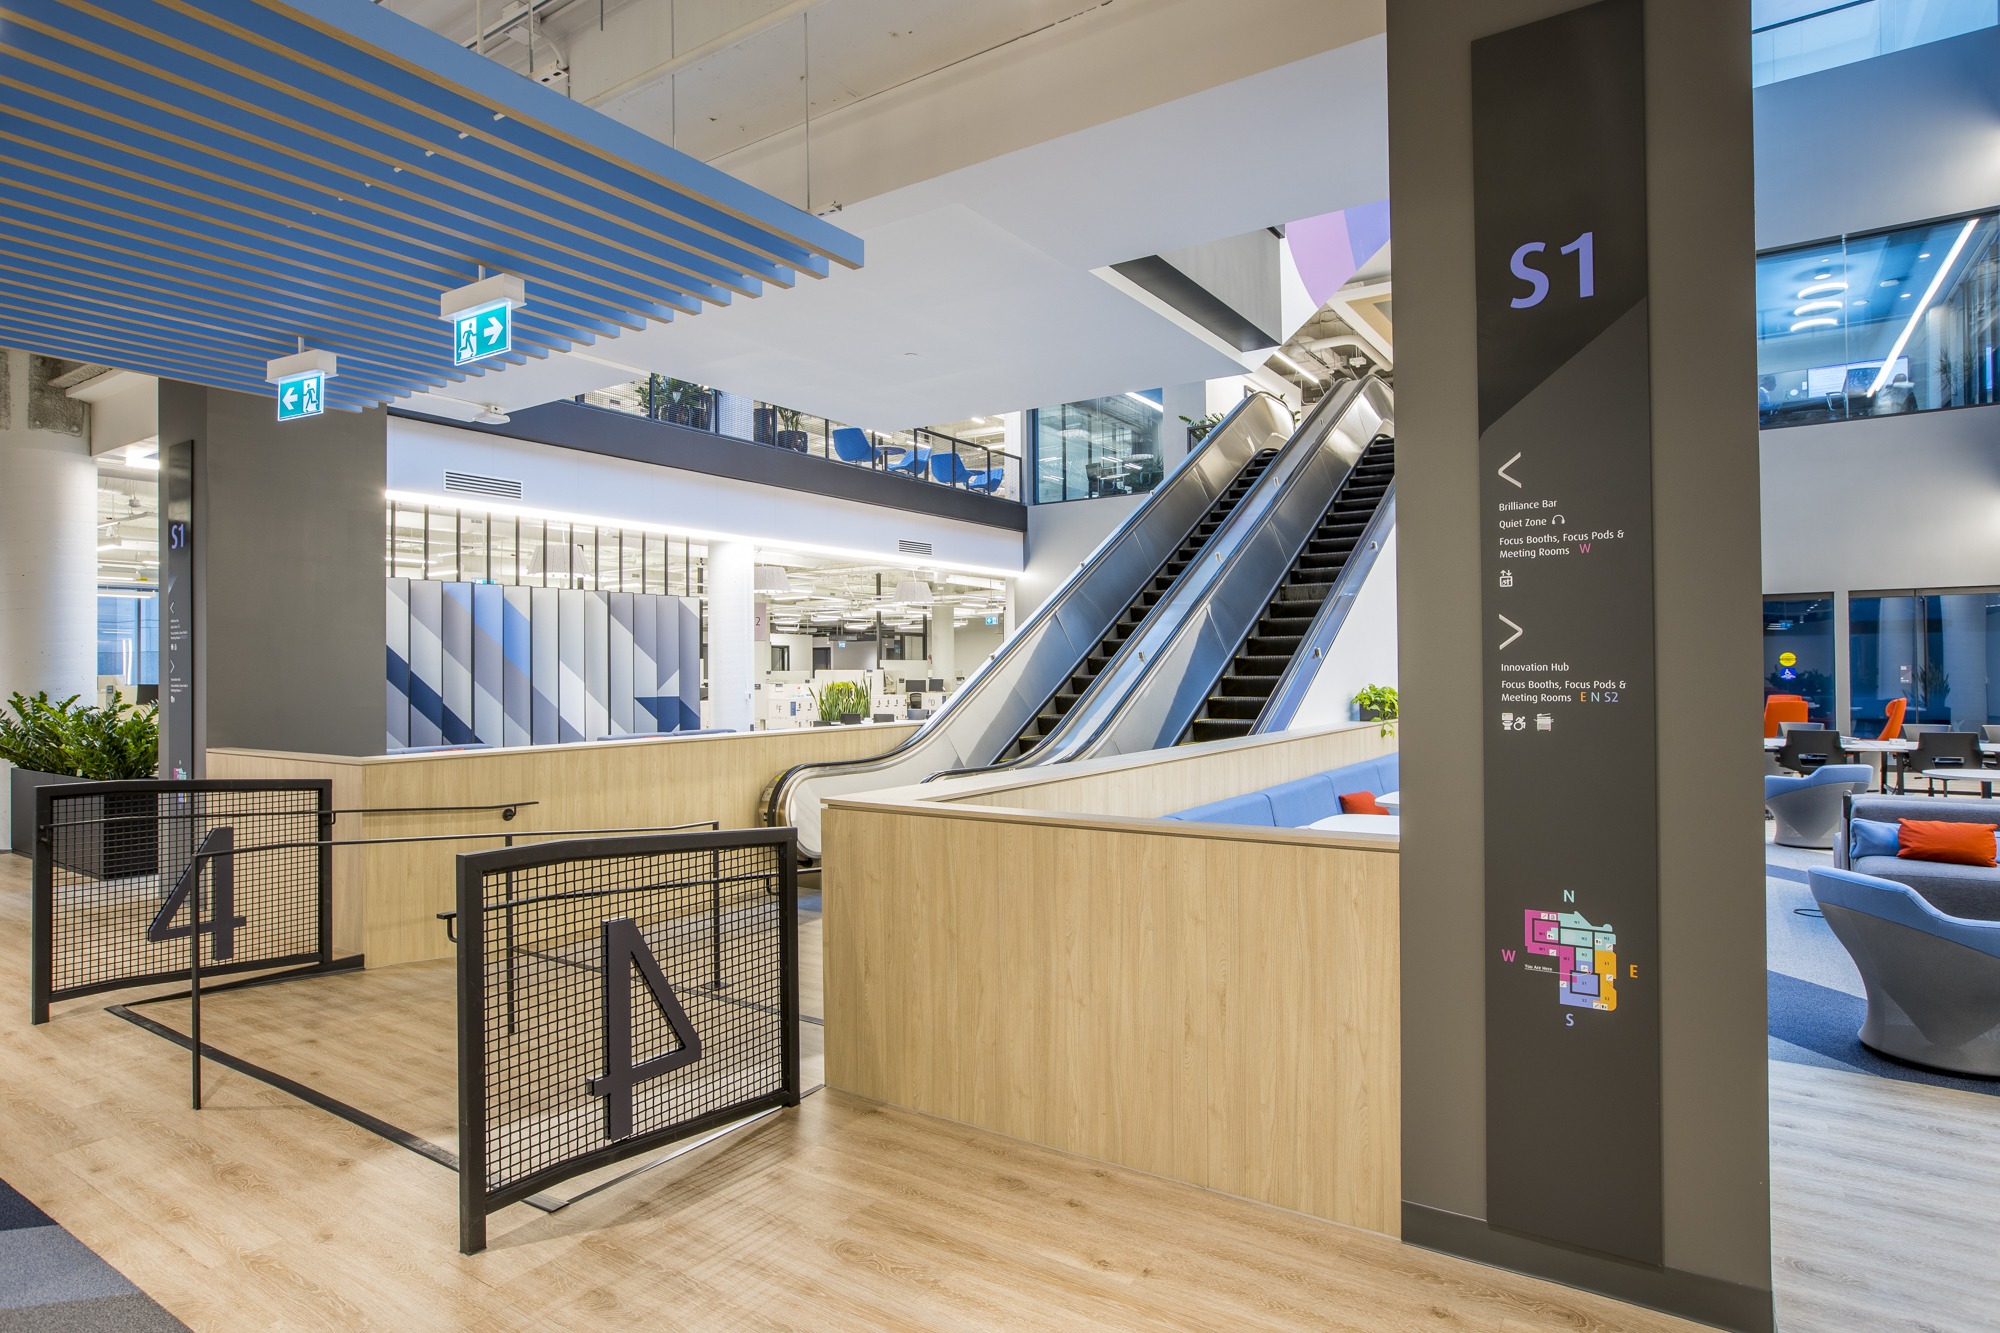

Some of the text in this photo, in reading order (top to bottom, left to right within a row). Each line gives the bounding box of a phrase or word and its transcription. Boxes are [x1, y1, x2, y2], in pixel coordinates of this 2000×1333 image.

[1510, 231, 1594, 309] S1
[1498, 499, 1558, 512] Brilliance Bar
[1499, 518, 1547, 530] Quiet Zone
[171, 523, 185, 549] S1
[1499, 529, 1625, 546] Focus Booths, Focus Pods &
[1499, 543, 1592, 559] Meeting Rooms W
[1501, 662, 1570, 672] Innovation Hub
[1501, 679, 1627, 690] Focus Booths, Focus Pods &
[1501, 691, 1619, 704] Meeting Rooms E N S2
[148, 827, 247, 961] 4
[1563, 889, 1575, 903] N
[1501, 949, 1516, 963] W
[1629, 964, 1639, 979] E
[1565, 1013, 1575, 1027] S
